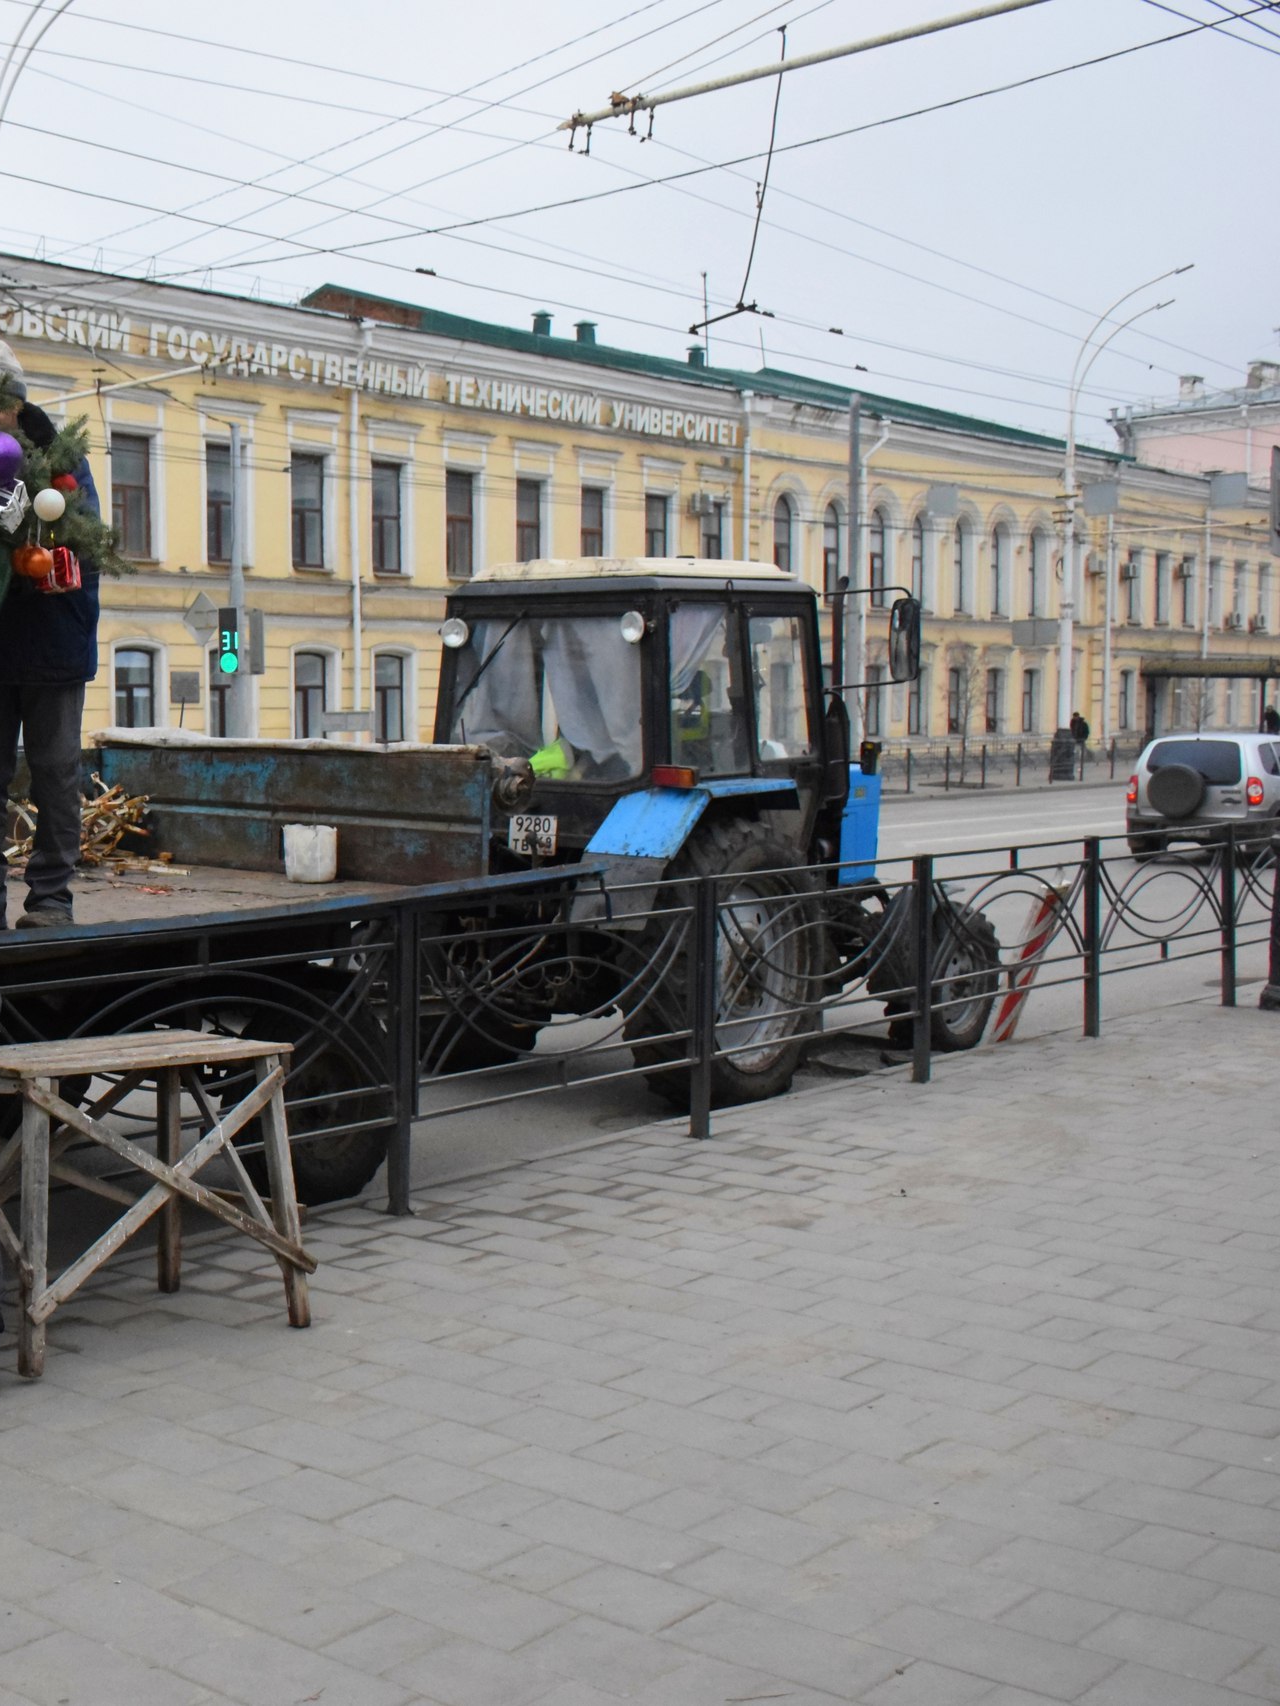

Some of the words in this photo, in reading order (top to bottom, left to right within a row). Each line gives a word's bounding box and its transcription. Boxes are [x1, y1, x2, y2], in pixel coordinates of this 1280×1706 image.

[149, 322, 429, 400] ГОСУДАРСТВЕННЫЙ
[445, 373, 601, 425] ТЕХНИЧЕСКИЙ
[612, 400, 739, 447] УНИВЕРСИТЕТ
[222, 631, 239, 651] 31
[515, 816, 551, 833] 9280
